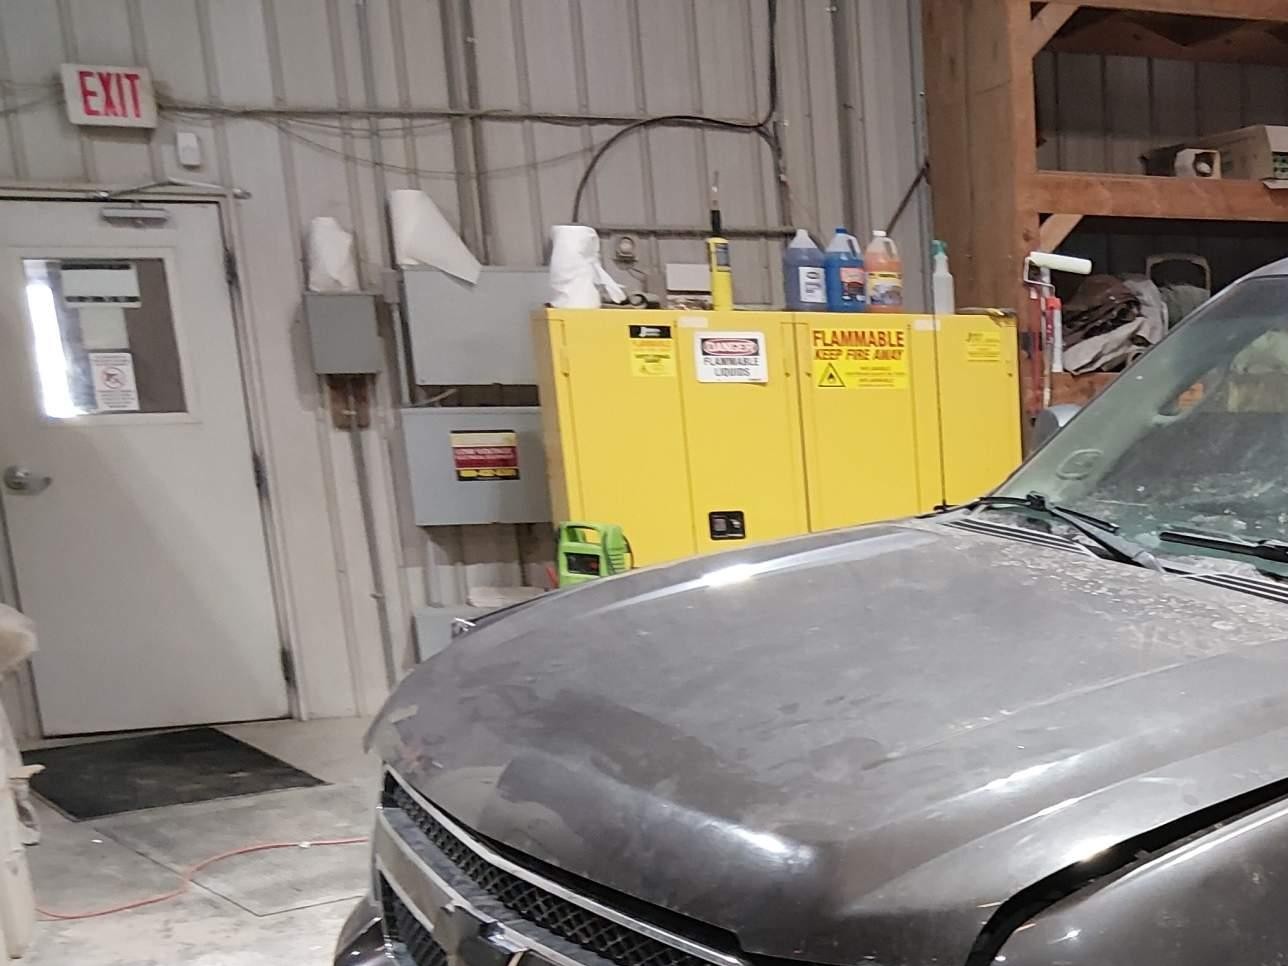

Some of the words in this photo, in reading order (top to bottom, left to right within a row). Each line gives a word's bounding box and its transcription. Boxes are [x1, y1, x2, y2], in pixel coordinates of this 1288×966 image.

[79, 71, 142, 118] EXIT
[812, 329, 905, 348] FLAMMABLE
[703, 341, 758, 353] DANGER
[815, 348, 843, 360] KEEP
[845, 348, 871, 360] FIRE
[873, 348, 905, 360] AWAY
[703, 357, 760, 366] FLAMMABLE
[713, 367, 752, 377] LIQUIDS
